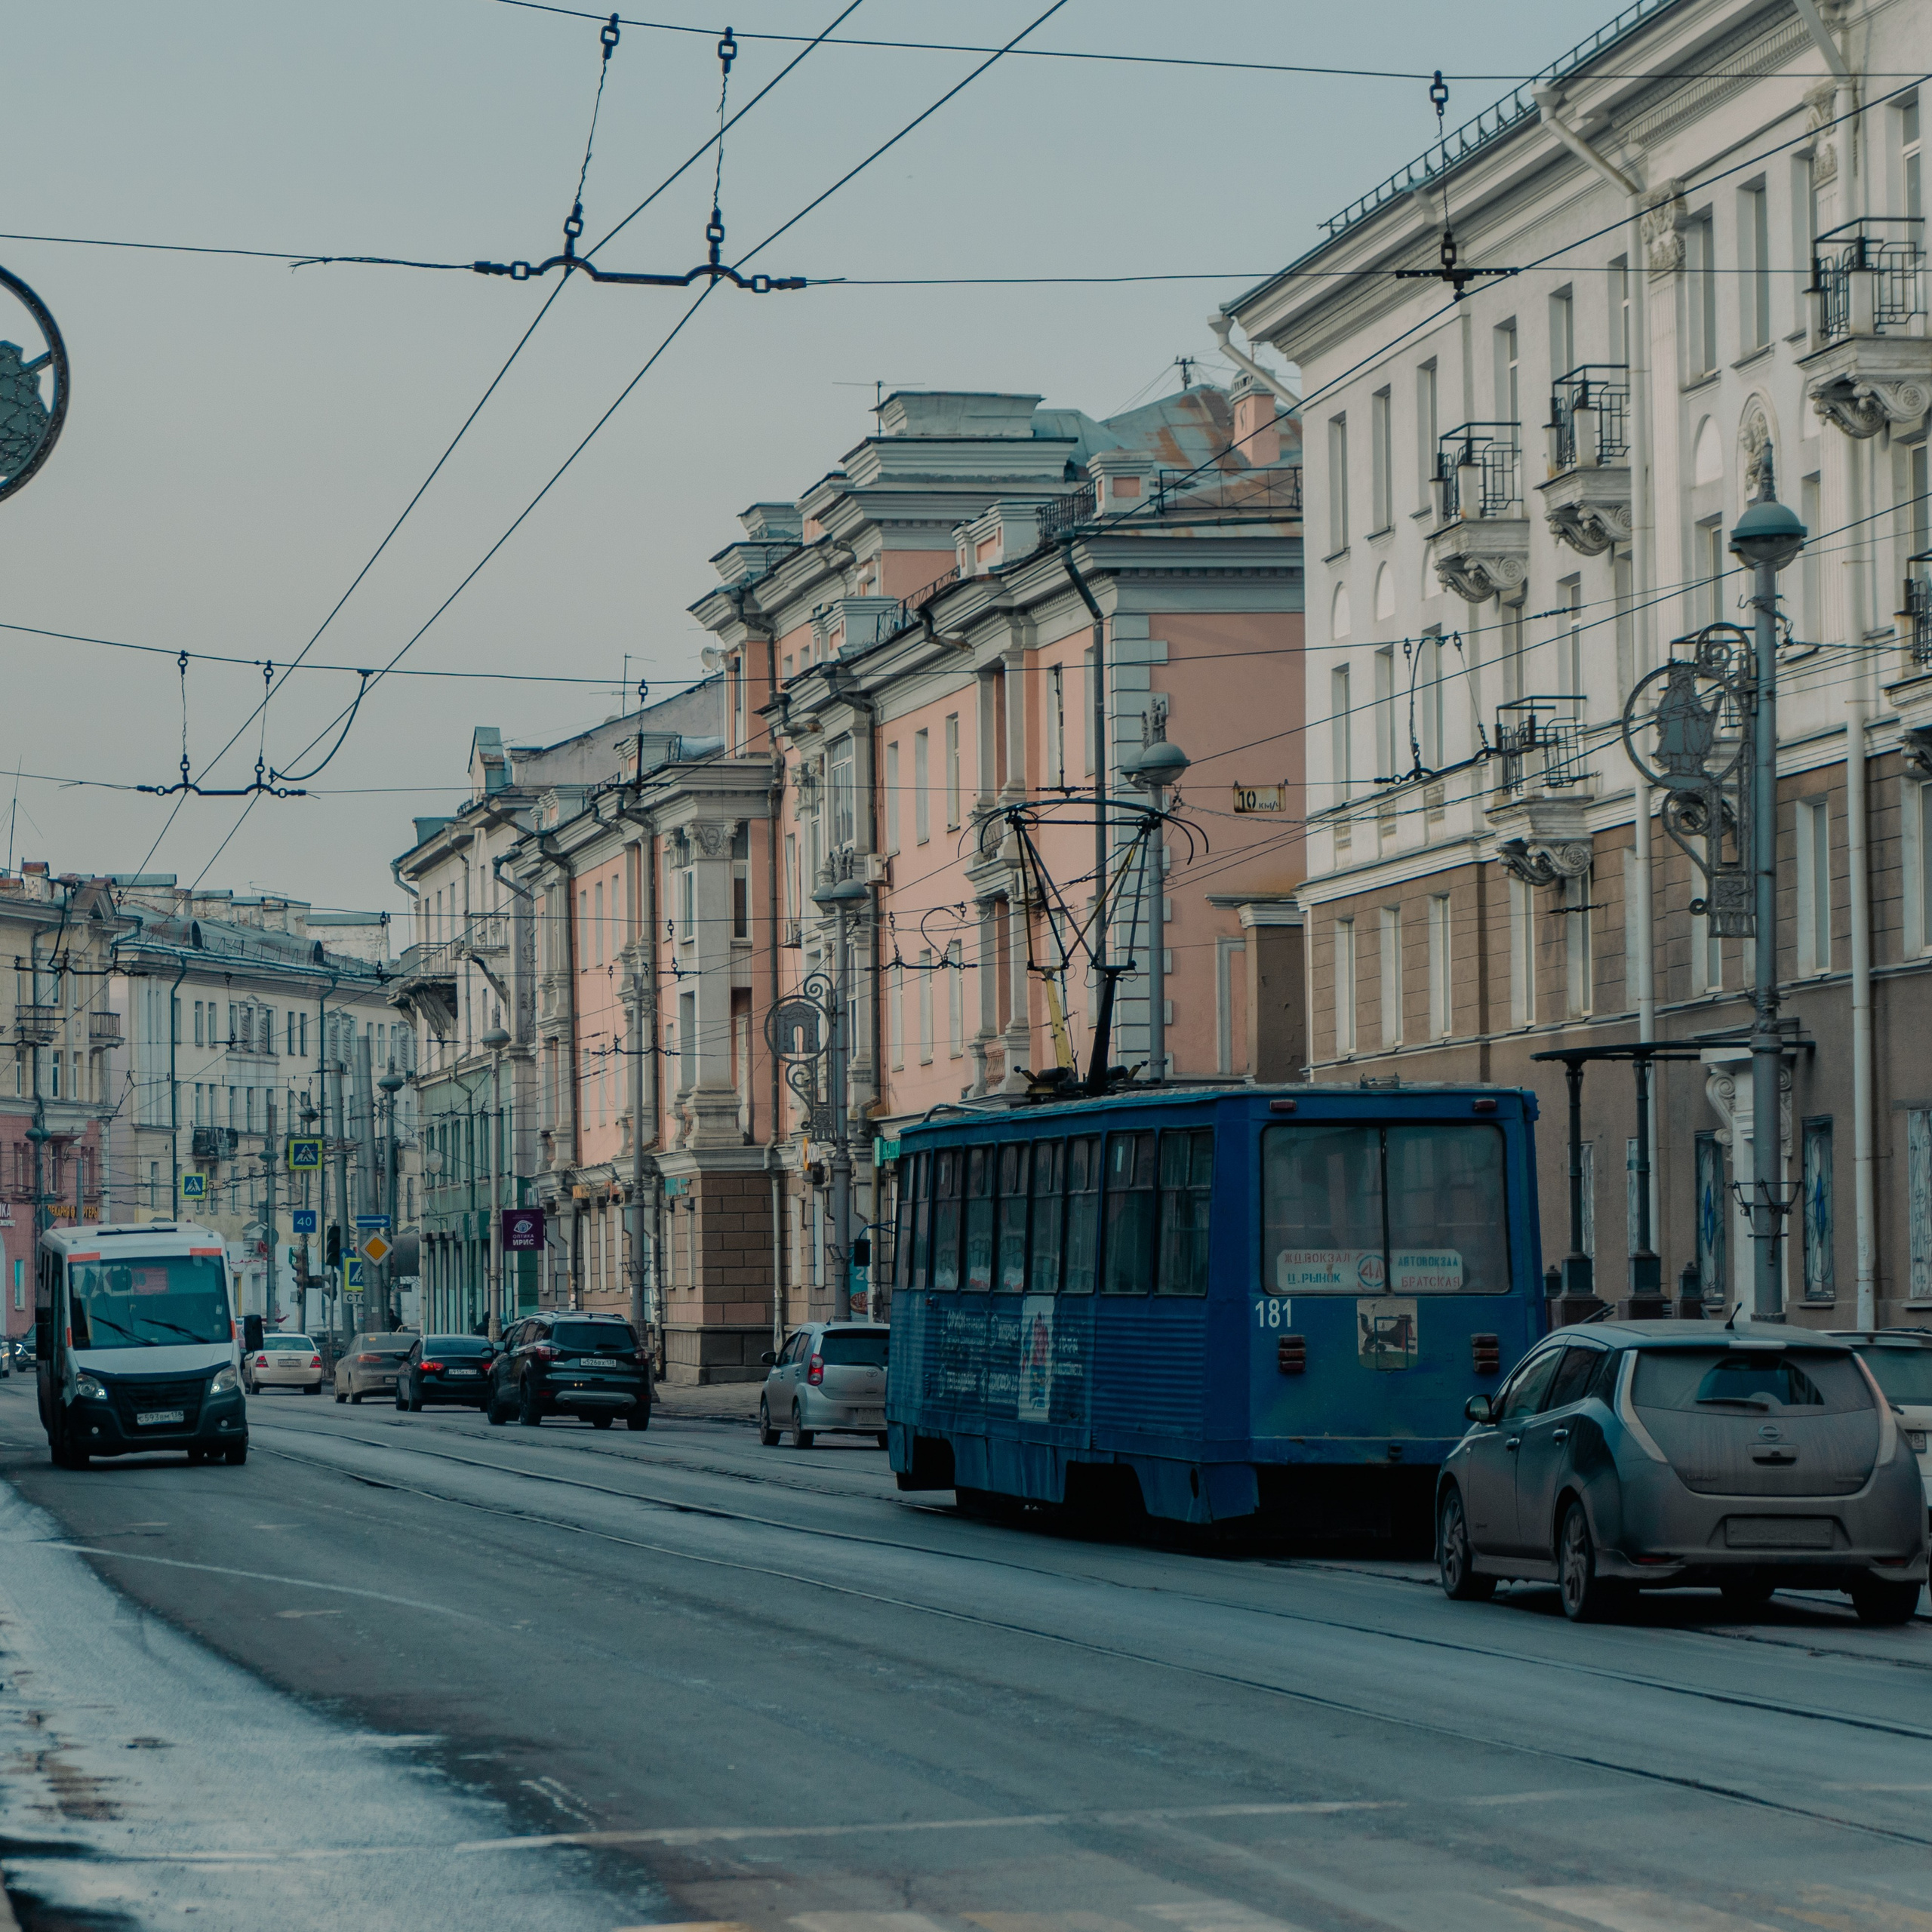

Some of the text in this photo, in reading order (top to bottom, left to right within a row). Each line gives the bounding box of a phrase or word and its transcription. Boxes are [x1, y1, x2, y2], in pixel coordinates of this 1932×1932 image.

[1238, 790, 1257, 809] 10
[297, 1217, 312, 1226] 40
[855, 1266, 868, 1281] 2
[1401, 1275, 1460, 1287] БРАТСКАЯ
[1255, 1298, 1292, 1328] 181
